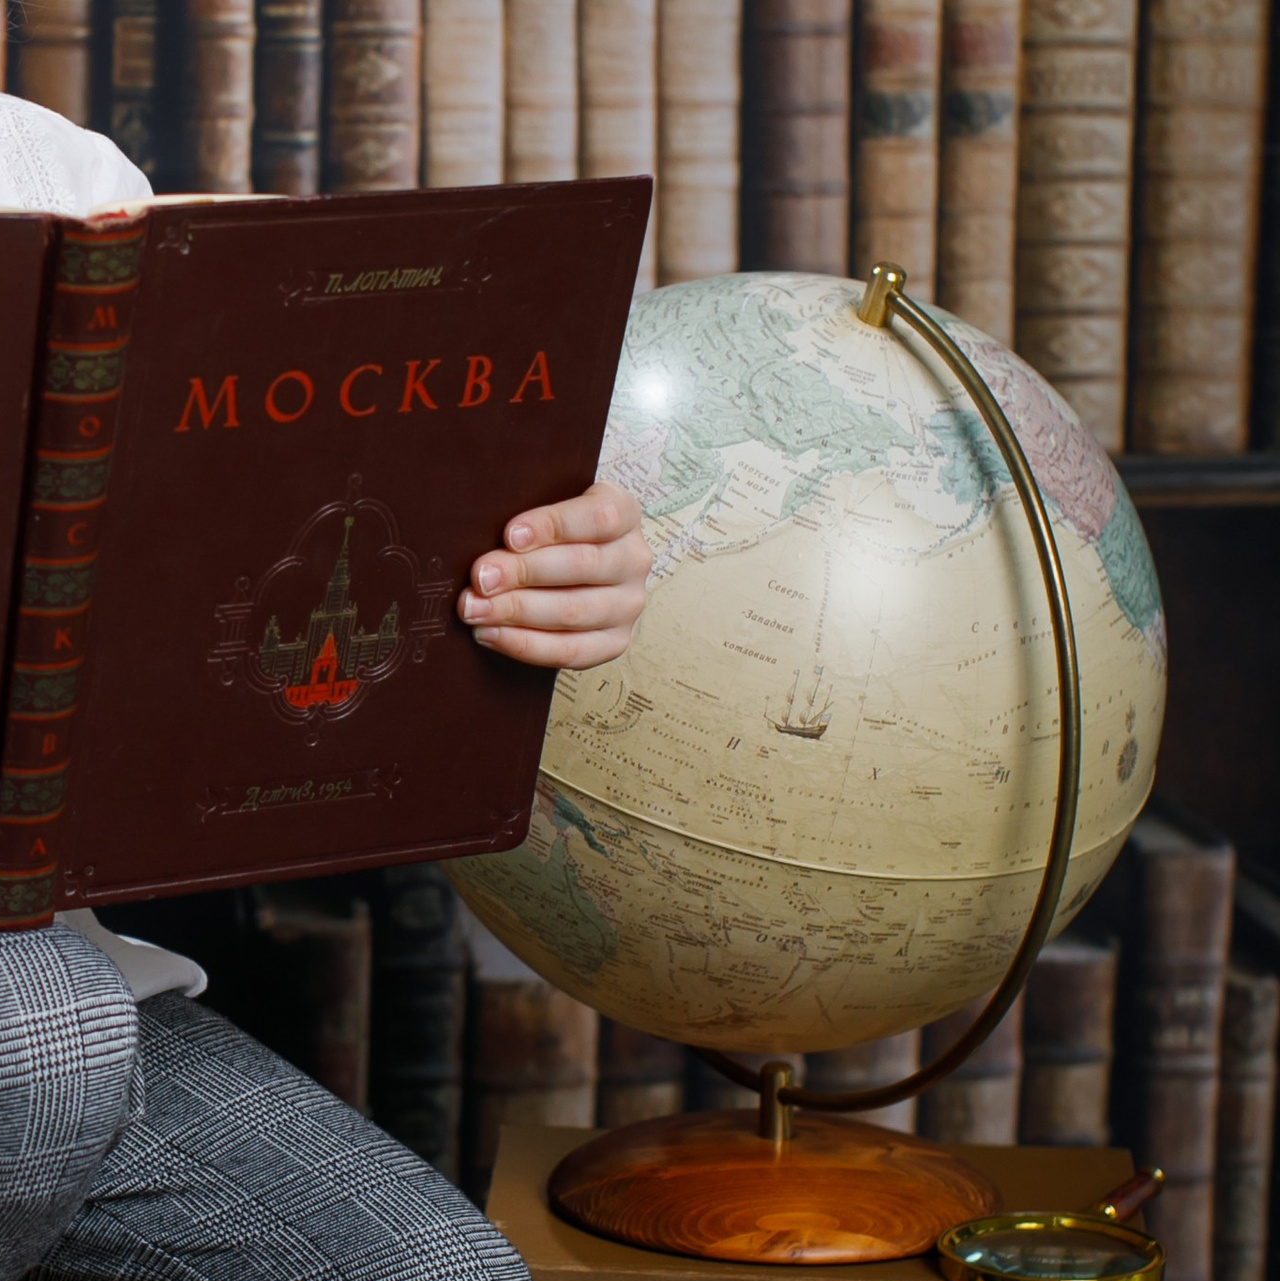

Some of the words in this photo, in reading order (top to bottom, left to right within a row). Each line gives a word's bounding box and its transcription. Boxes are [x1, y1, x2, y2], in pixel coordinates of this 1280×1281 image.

[174, 350, 556, 432] МОСКВА
[737, 460, 781, 488] ОХОТСКОЕ
[746, 480, 770, 496] МОРЕ
[768, 579, 810, 601] Северо-
[741, 609, 795, 634] -Западная
[722, 641, 778, 665] котловина
